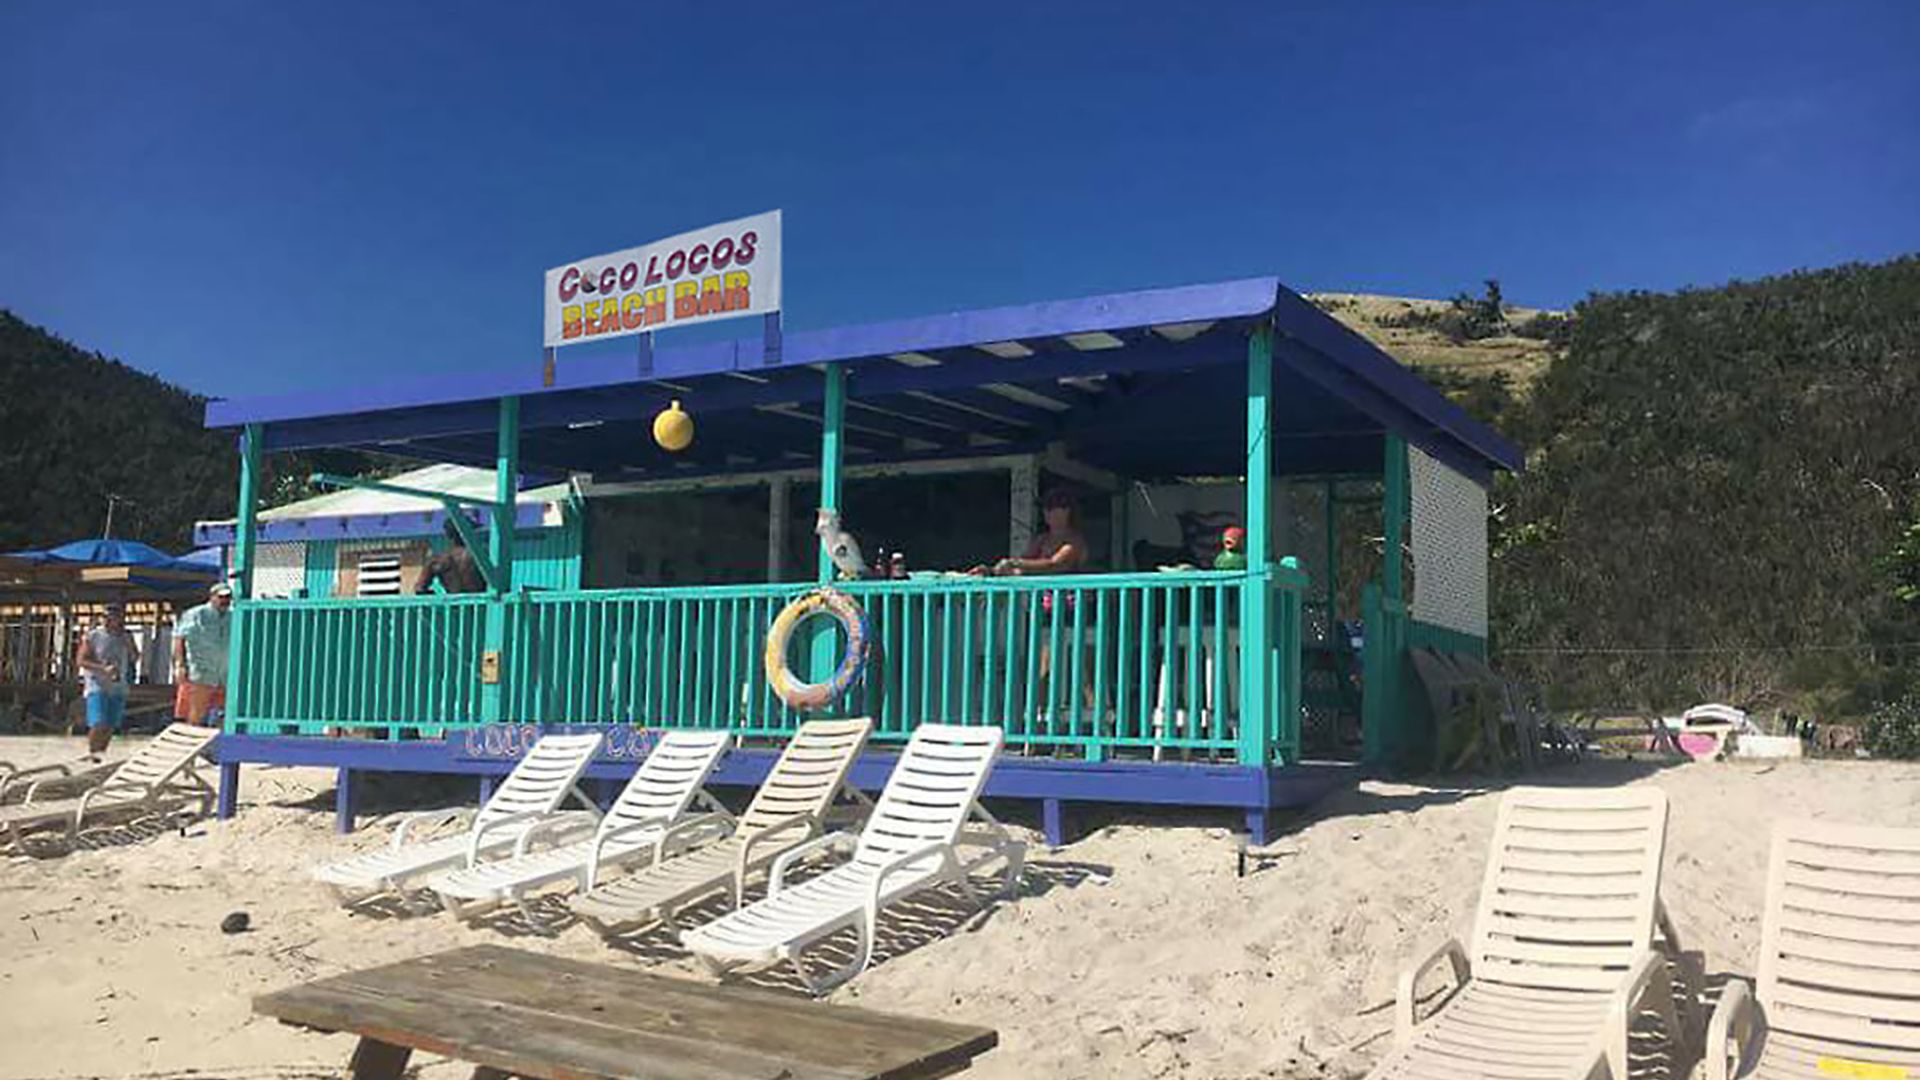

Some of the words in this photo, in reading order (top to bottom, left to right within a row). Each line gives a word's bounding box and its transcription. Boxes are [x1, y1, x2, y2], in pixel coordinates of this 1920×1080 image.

[644, 231, 758, 286] LOCOS
[563, 287, 666, 339] BEACH
[673, 270, 750, 320] BAR
